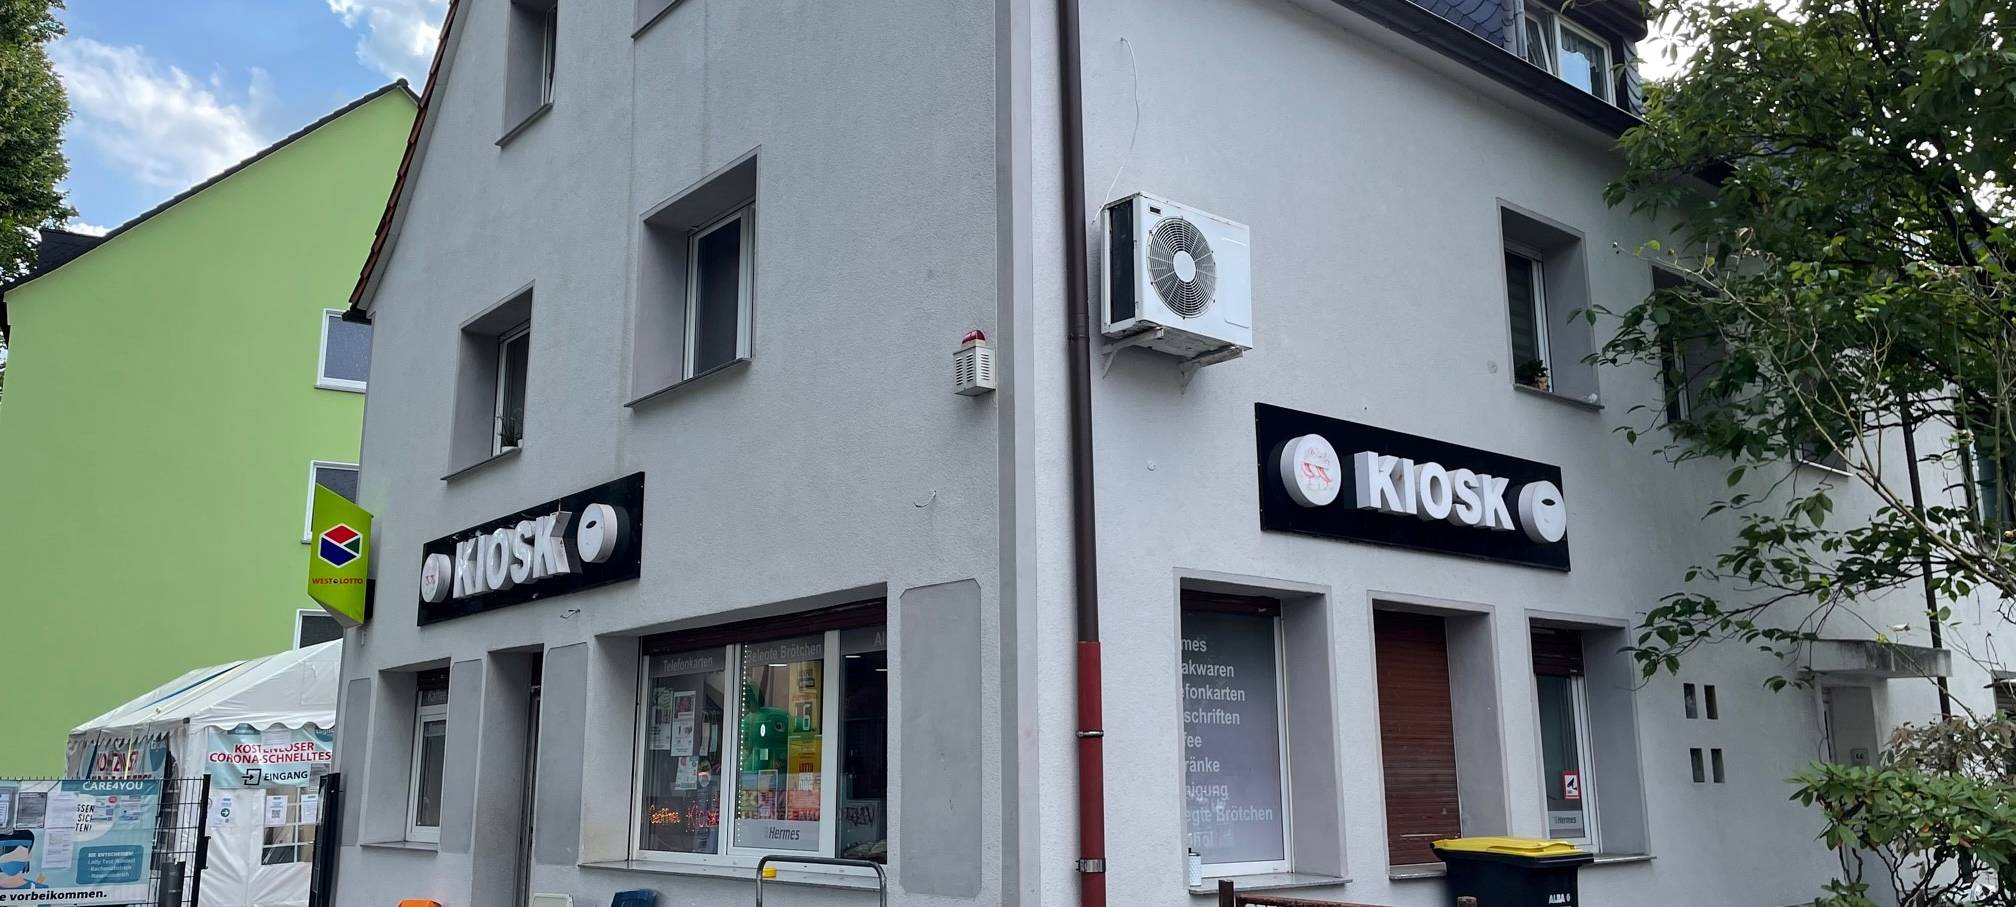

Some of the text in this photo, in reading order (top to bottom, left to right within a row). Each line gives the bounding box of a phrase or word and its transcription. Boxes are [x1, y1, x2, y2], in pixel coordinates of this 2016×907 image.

[1354, 451, 1515, 531] KIOSK
[453, 511, 571, 598] KIOSK
[779, 643, 823, 659] Brötchen
[1184, 708, 1240, 725] schriften
[264, 771, 308, 781] EINGANG
[83, 781, 143, 791] CARE4YOU
[1216, 804, 1273, 822] Brötchen
[768, 826, 801, 840] Hermes
[10, 889, 108, 902] vorbeikommen.
[1549, 894, 1566, 904] ALBA
